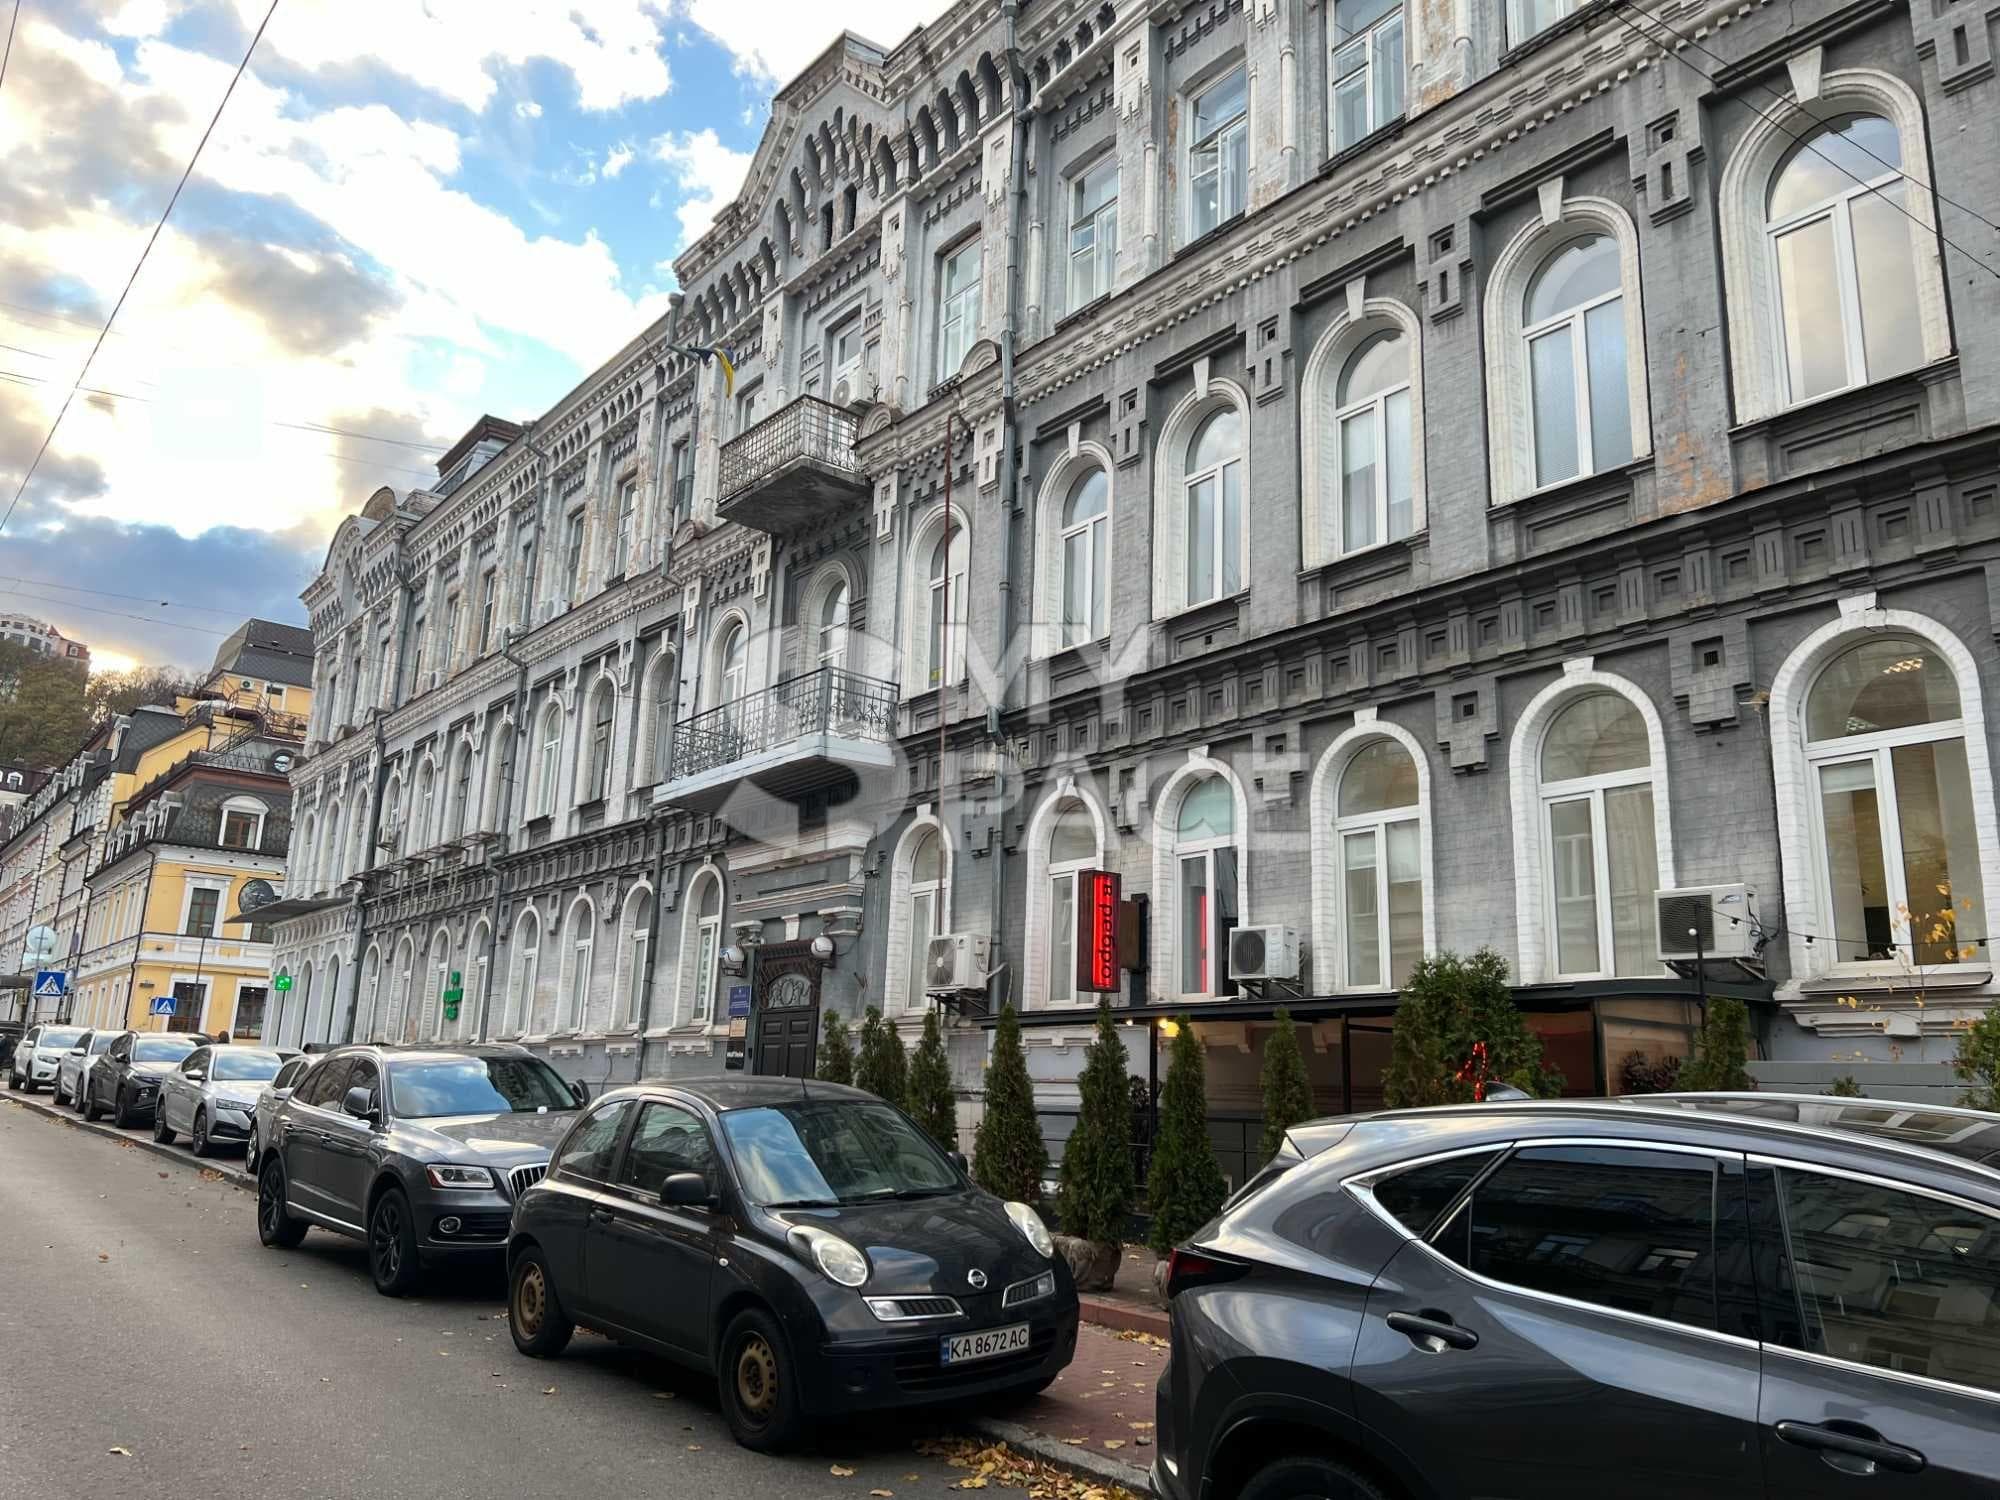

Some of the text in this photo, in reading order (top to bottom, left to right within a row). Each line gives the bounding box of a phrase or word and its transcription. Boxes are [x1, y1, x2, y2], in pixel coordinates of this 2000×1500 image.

[1099, 904, 1115, 979] ребро
[951, 1328, 1027, 1359] KA 8672 AC
